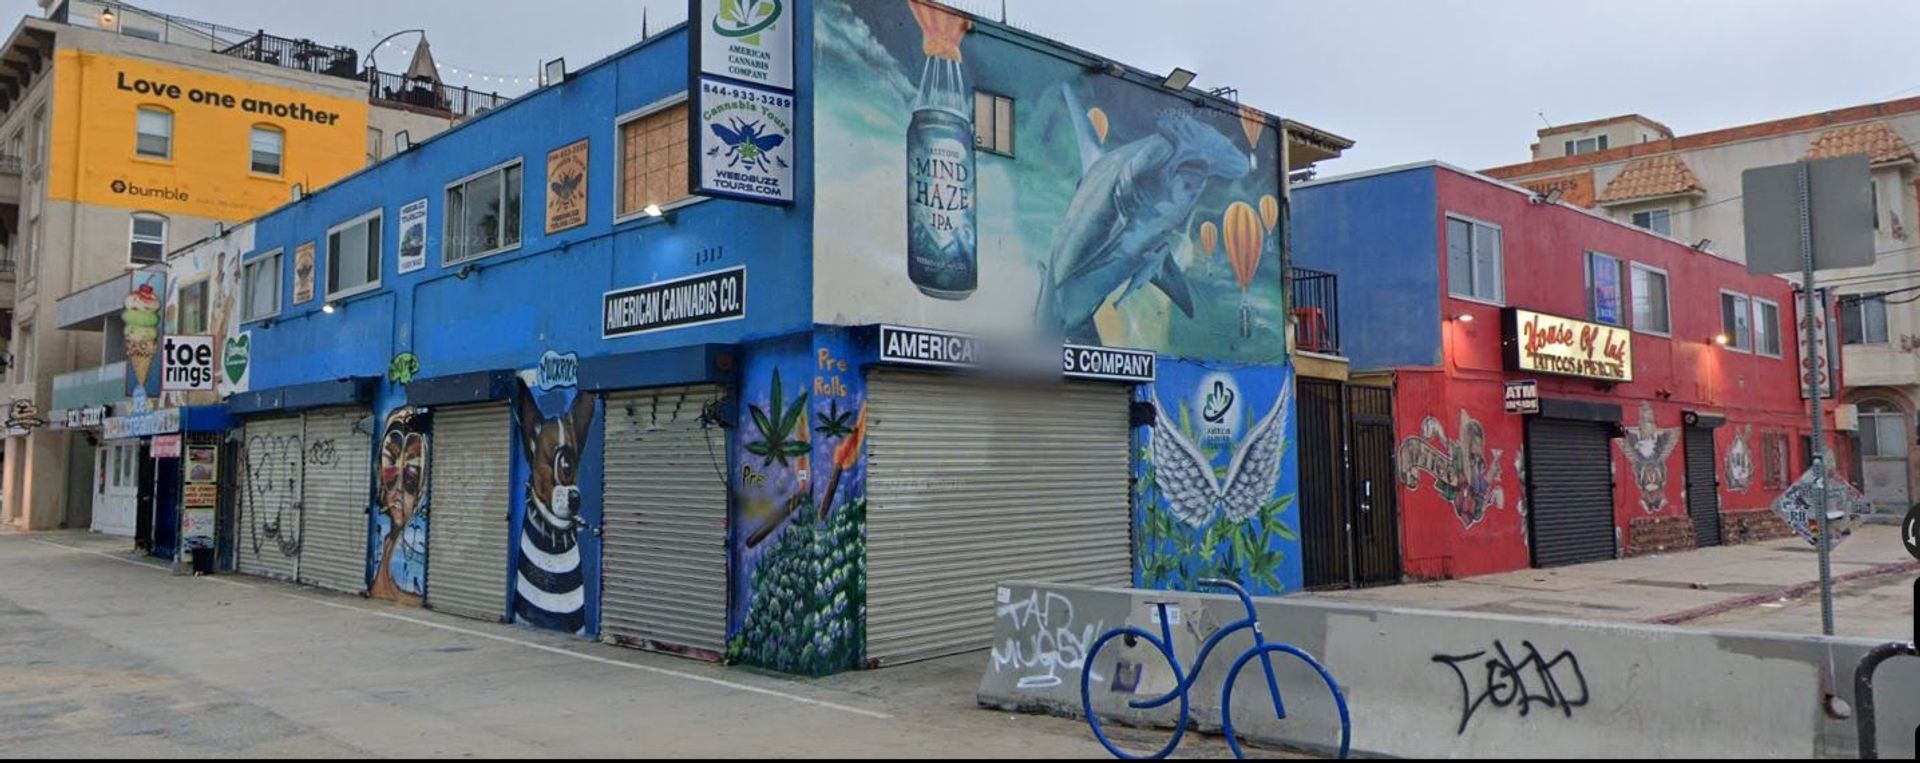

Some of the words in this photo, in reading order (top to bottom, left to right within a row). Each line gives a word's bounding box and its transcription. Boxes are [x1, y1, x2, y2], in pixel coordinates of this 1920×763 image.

[729, 45, 771, 60] AMERICAN
[729, 55, 769, 70] CANNABIS
[729, 65, 768, 80] COMPANY
[117, 71, 182, 99] Love
[188, 88, 236, 109] one
[241, 97, 339, 126] another
[703, 83, 791, 108] 844-933-3289
[703, 100, 758, 122] Cannabis
[761, 106, 791, 136] Tours
[716, 170, 780, 187] WEEDBUZZ
[915, 157, 969, 182] MIND
[128, 182, 189, 202] bumble
[713, 179, 782, 196] TOURS.COM
[914, 181, 969, 211] HAZE
[931, 213, 953, 231] IPA
[696, 246, 723, 266] 1313
[606, 292, 660, 330] AMERICAN
[662, 280, 717, 322] CANNABIS
[720, 276, 739, 312] CO.
[1523, 314, 1575, 357] House
[1580, 324, 1599, 359] Of
[1604, 329, 1626, 361] Ink
[164, 338, 212, 365] toe
[817, 347, 848, 371] Pre
[1079, 352, 1151, 376] COMPANY
[165, 366, 212, 387] rings
[813, 376, 848, 396] Rolls
[1505, 385, 1537, 399] ATM
[743, 464, 768, 488] Pre
